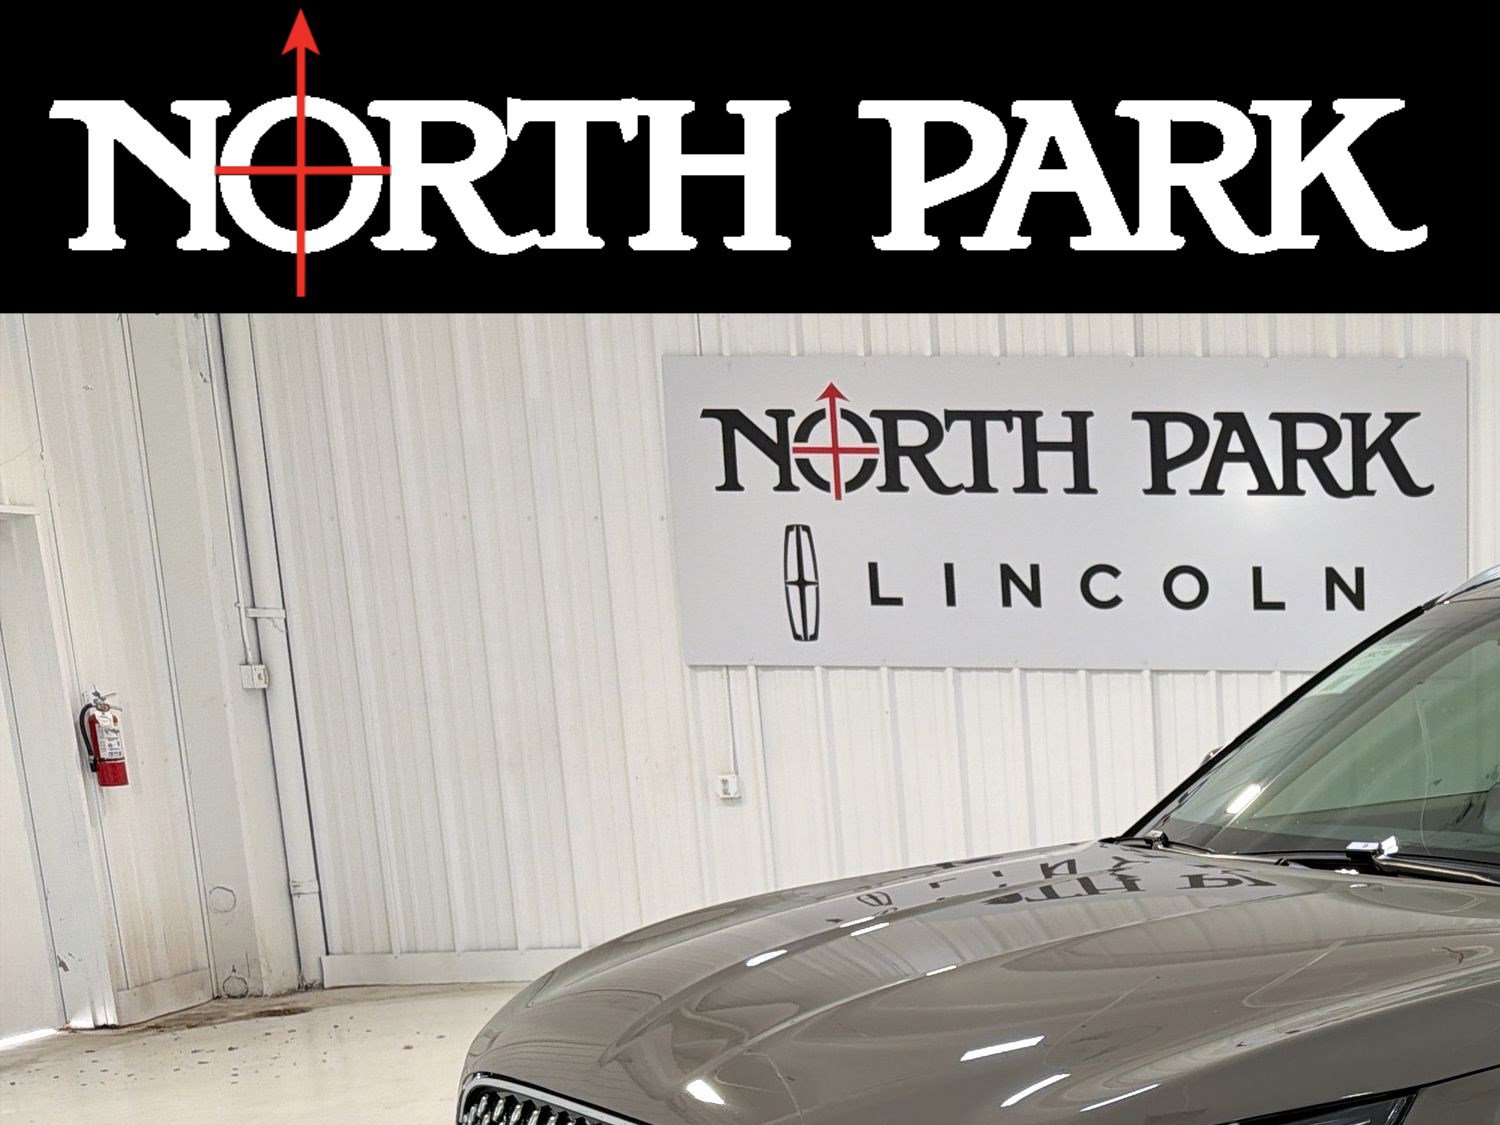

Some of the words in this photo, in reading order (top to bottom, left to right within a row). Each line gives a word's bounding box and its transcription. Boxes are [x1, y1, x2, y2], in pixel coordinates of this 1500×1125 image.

[700, 406, 1097, 497] NORTH
[1131, 410, 1435, 499] PARK
[868, 561, 1365, 611] LINCOLN
